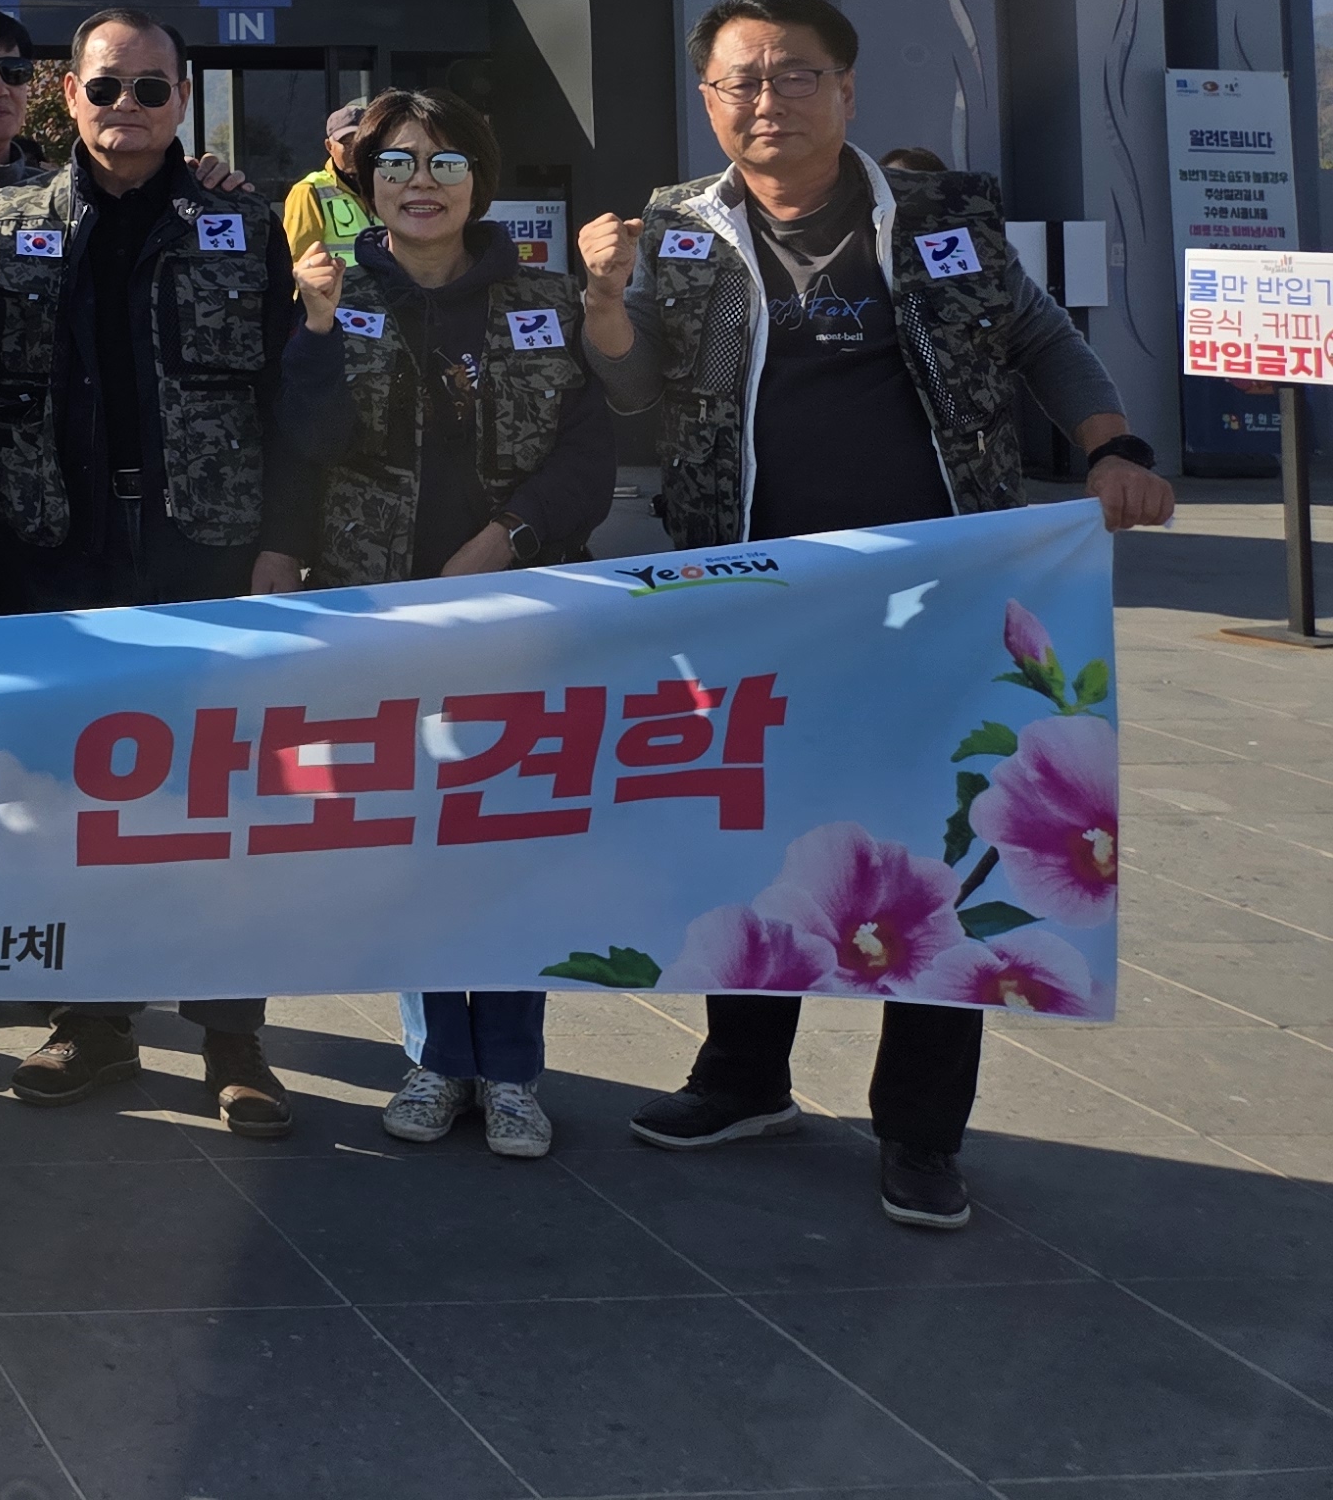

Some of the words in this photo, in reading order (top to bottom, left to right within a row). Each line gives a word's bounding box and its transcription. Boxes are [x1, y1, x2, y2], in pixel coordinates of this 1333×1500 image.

[228, 12, 265, 41] IN
[1189, 129, 1273, 149] 알려드립니다
[1188, 268, 1248, 303] 물만
[815, 332, 864, 341] mont-bell
[1188, 308, 1242, 338] 음식
[1189, 339, 1323, 379] 반입금지
[614, 558, 779, 589] Yeonsu
[73, 672, 789, 867] 안보견학
